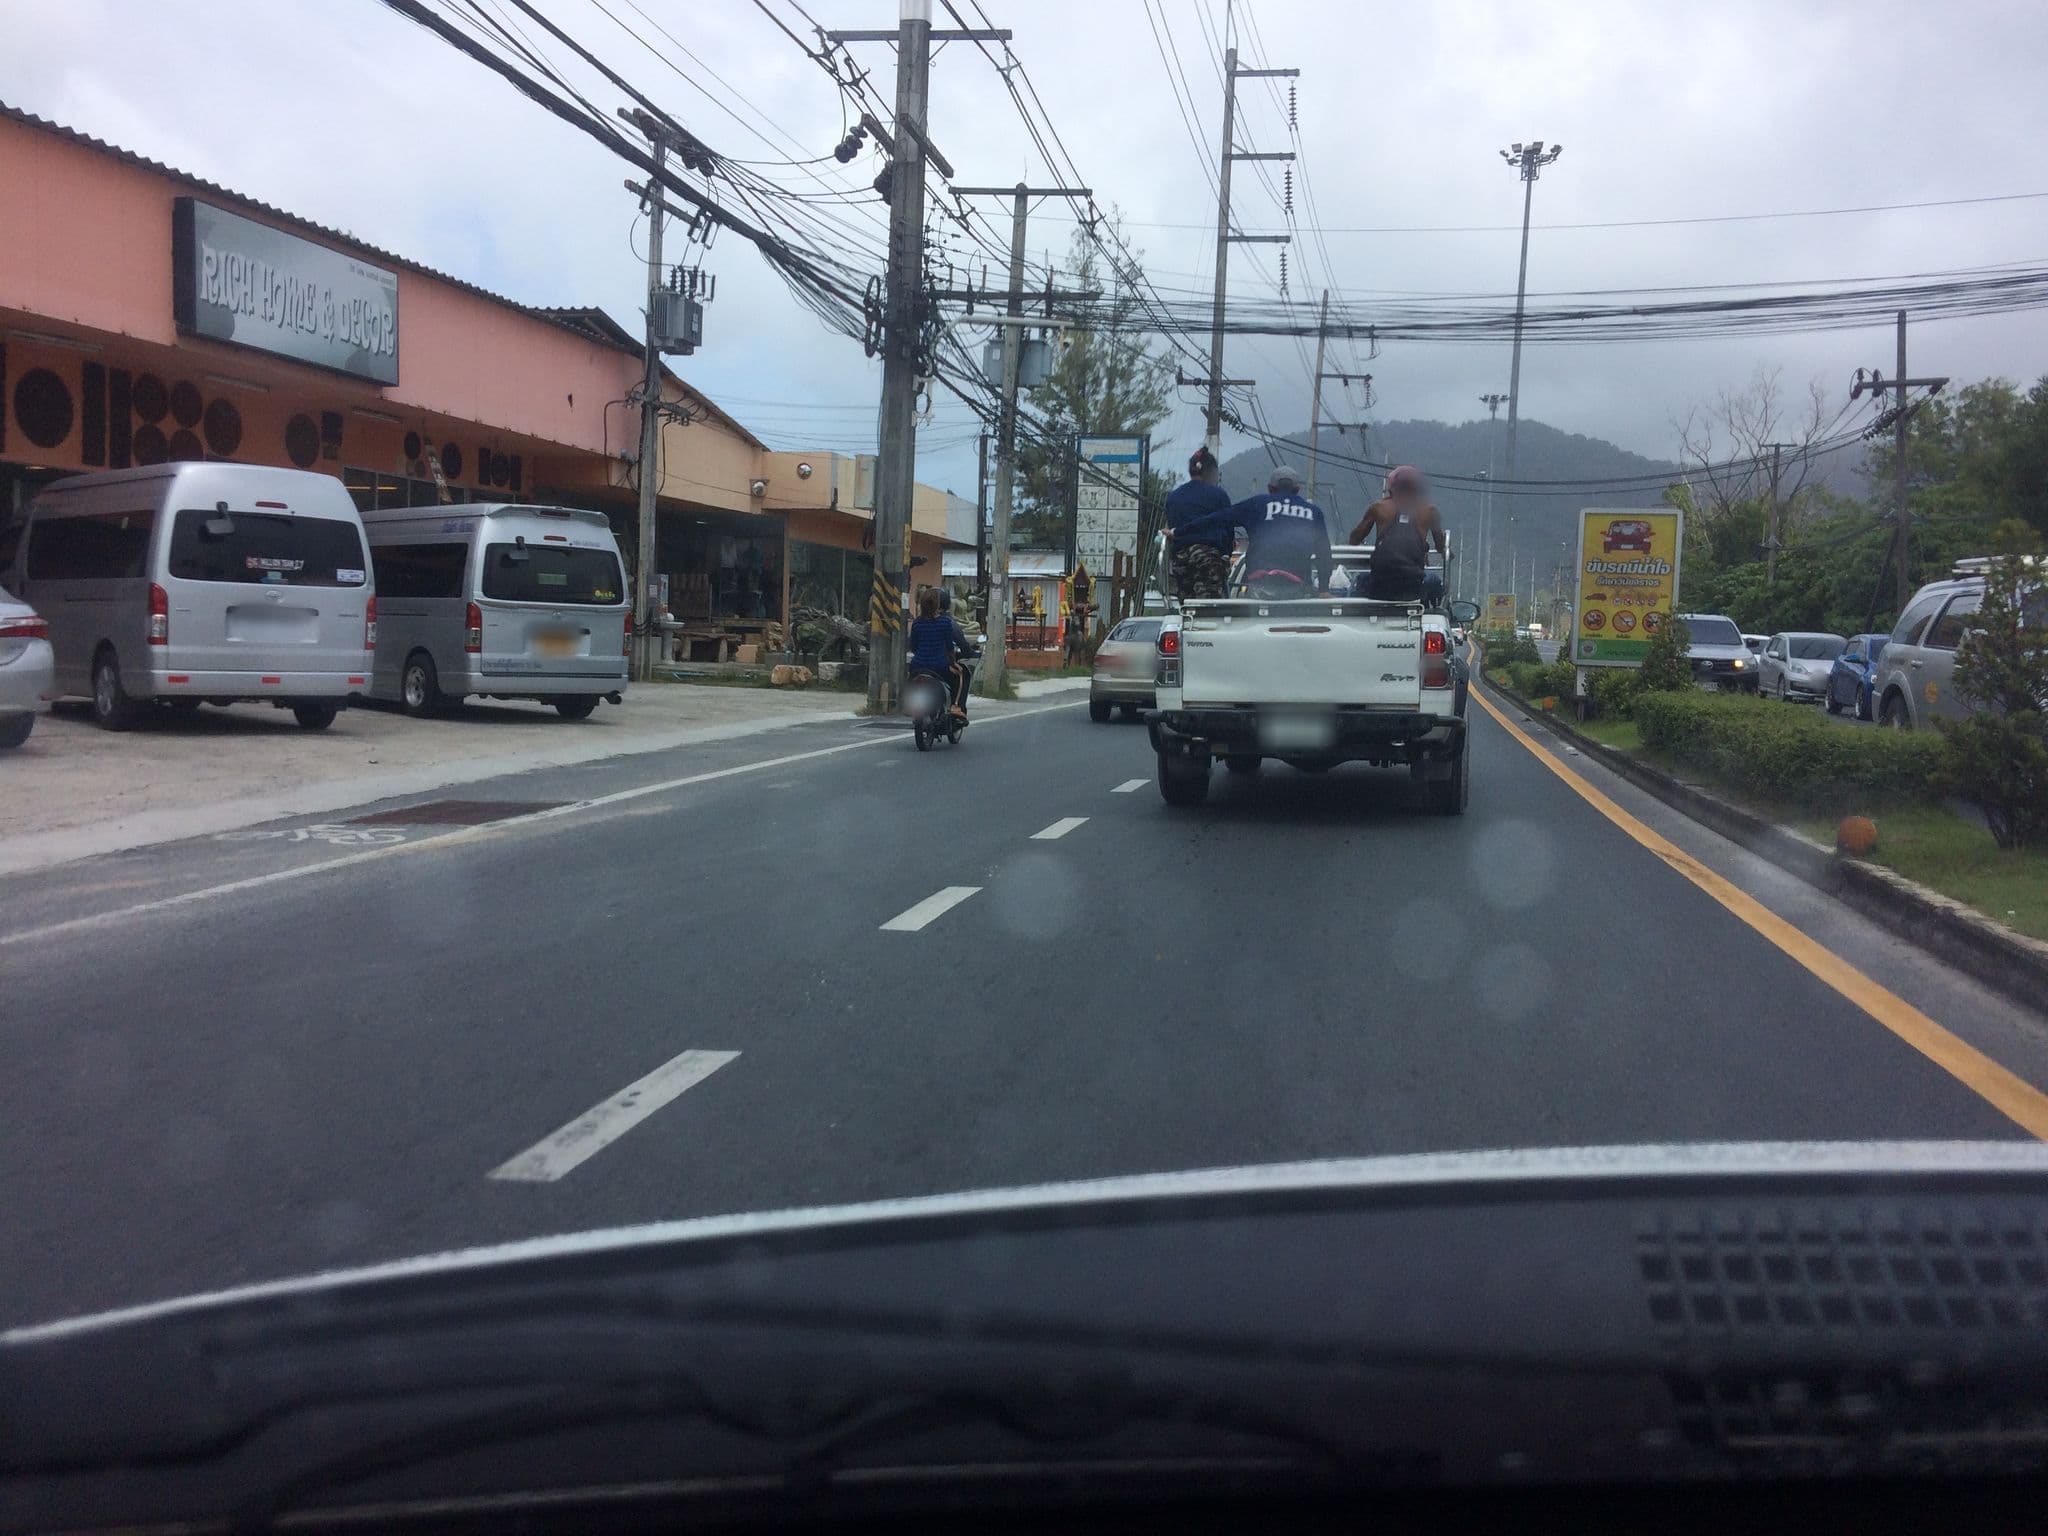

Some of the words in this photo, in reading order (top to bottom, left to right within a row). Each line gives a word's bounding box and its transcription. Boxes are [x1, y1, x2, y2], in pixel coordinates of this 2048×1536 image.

[201, 243, 256, 315] RICH
[261, 266, 318, 335] HOME
[322, 288, 336, 344] &
[340, 299, 396, 357] DECOR
[1265, 499, 1314, 521] pim
